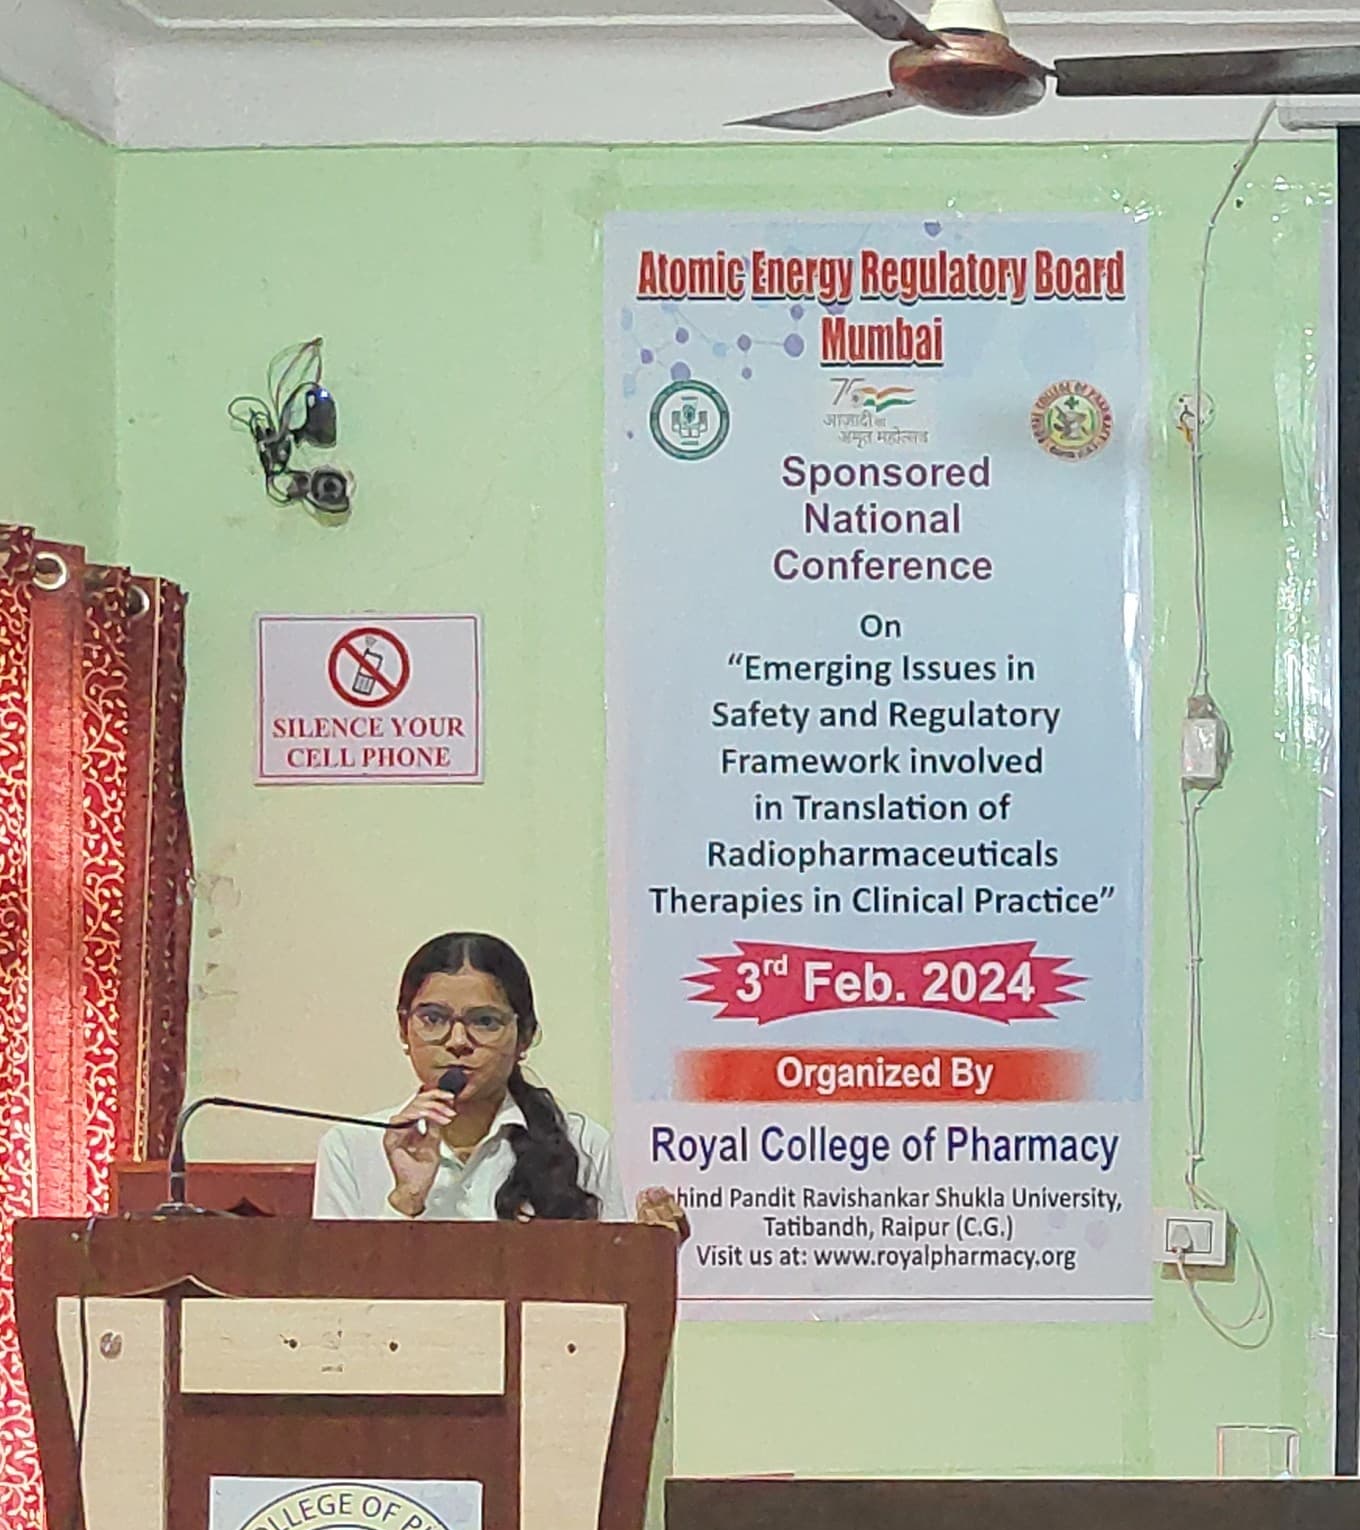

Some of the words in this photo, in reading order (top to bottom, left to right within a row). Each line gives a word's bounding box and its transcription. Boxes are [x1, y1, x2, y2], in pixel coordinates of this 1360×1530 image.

[638, 249, 745, 297] Atomic
[751, 249, 852, 301] Energy
[860, 249, 1028, 303] Regulatory
[1034, 249, 1125, 297] Board
[821, 317, 943, 364] Mumbai
[782, 455, 991, 495] Sponsored
[804, 502, 961, 535] National
[774, 549, 993, 582] Conference
[860, 614, 901, 639] On
[728, 654, 891, 686] “Emerging
[902, 655, 995, 682] Issues
[1007, 654, 1035, 682] in
[272, 717, 384, 738] SILENCE
[391, 717, 465, 737] YOUR
[712, 701, 810, 734] Safety
[820, 701, 877, 728] and
[889, 701, 1060, 734] Regulatory
[286, 748, 355, 768] CELL
[362, 747, 451, 768] PHONE
[721, 747, 900, 775] Framework
[910, 747, 1043, 775] involved
[754, 794, 783, 821] in
[793, 794, 970, 822] Translation
[978, 792, 1011, 822] of
[708, 840, 1058, 873] Radiopharmaceuticals
[649, 885, 803, 919] Therapies
[814, 885, 841, 914] in
[852, 884, 965, 915] Clinical
[975, 884, 1115, 915] Practice”
[736, 954, 788, 1002] 3rd
[804, 961, 905, 1002] Feb.
[922, 961, 1036, 1002] 2024
[776, 1057, 940, 1092] Organized
[951, 1056, 993, 1095] By
[652, 1126, 748, 1170] Royal
[761, 1125, 890, 1170] College
[902, 1124, 936, 1162] of
[947, 1125, 1119, 1170] Pharmacy
[674, 1188, 722, 1209] hind
[730, 1188, 797, 1209] Pandit
[803, 1188, 929, 1209] Ravishankar
[935, 1188, 1005, 1209] Shukla
[1012, 1187, 1123, 1211] University,
[763, 1216, 874, 1240] Tatibandh,
[881, 1216, 949, 1240] Raipur
[955, 1216, 1014, 1241] (C.G.)
[697, 1245, 744, 1267] Visit
[749, 1249, 773, 1267] us
[779, 1246, 808, 1267] at:
[814, 1245, 1076, 1270] www.royalpharmacy.org
[362, 1496, 402, 1522] OF
